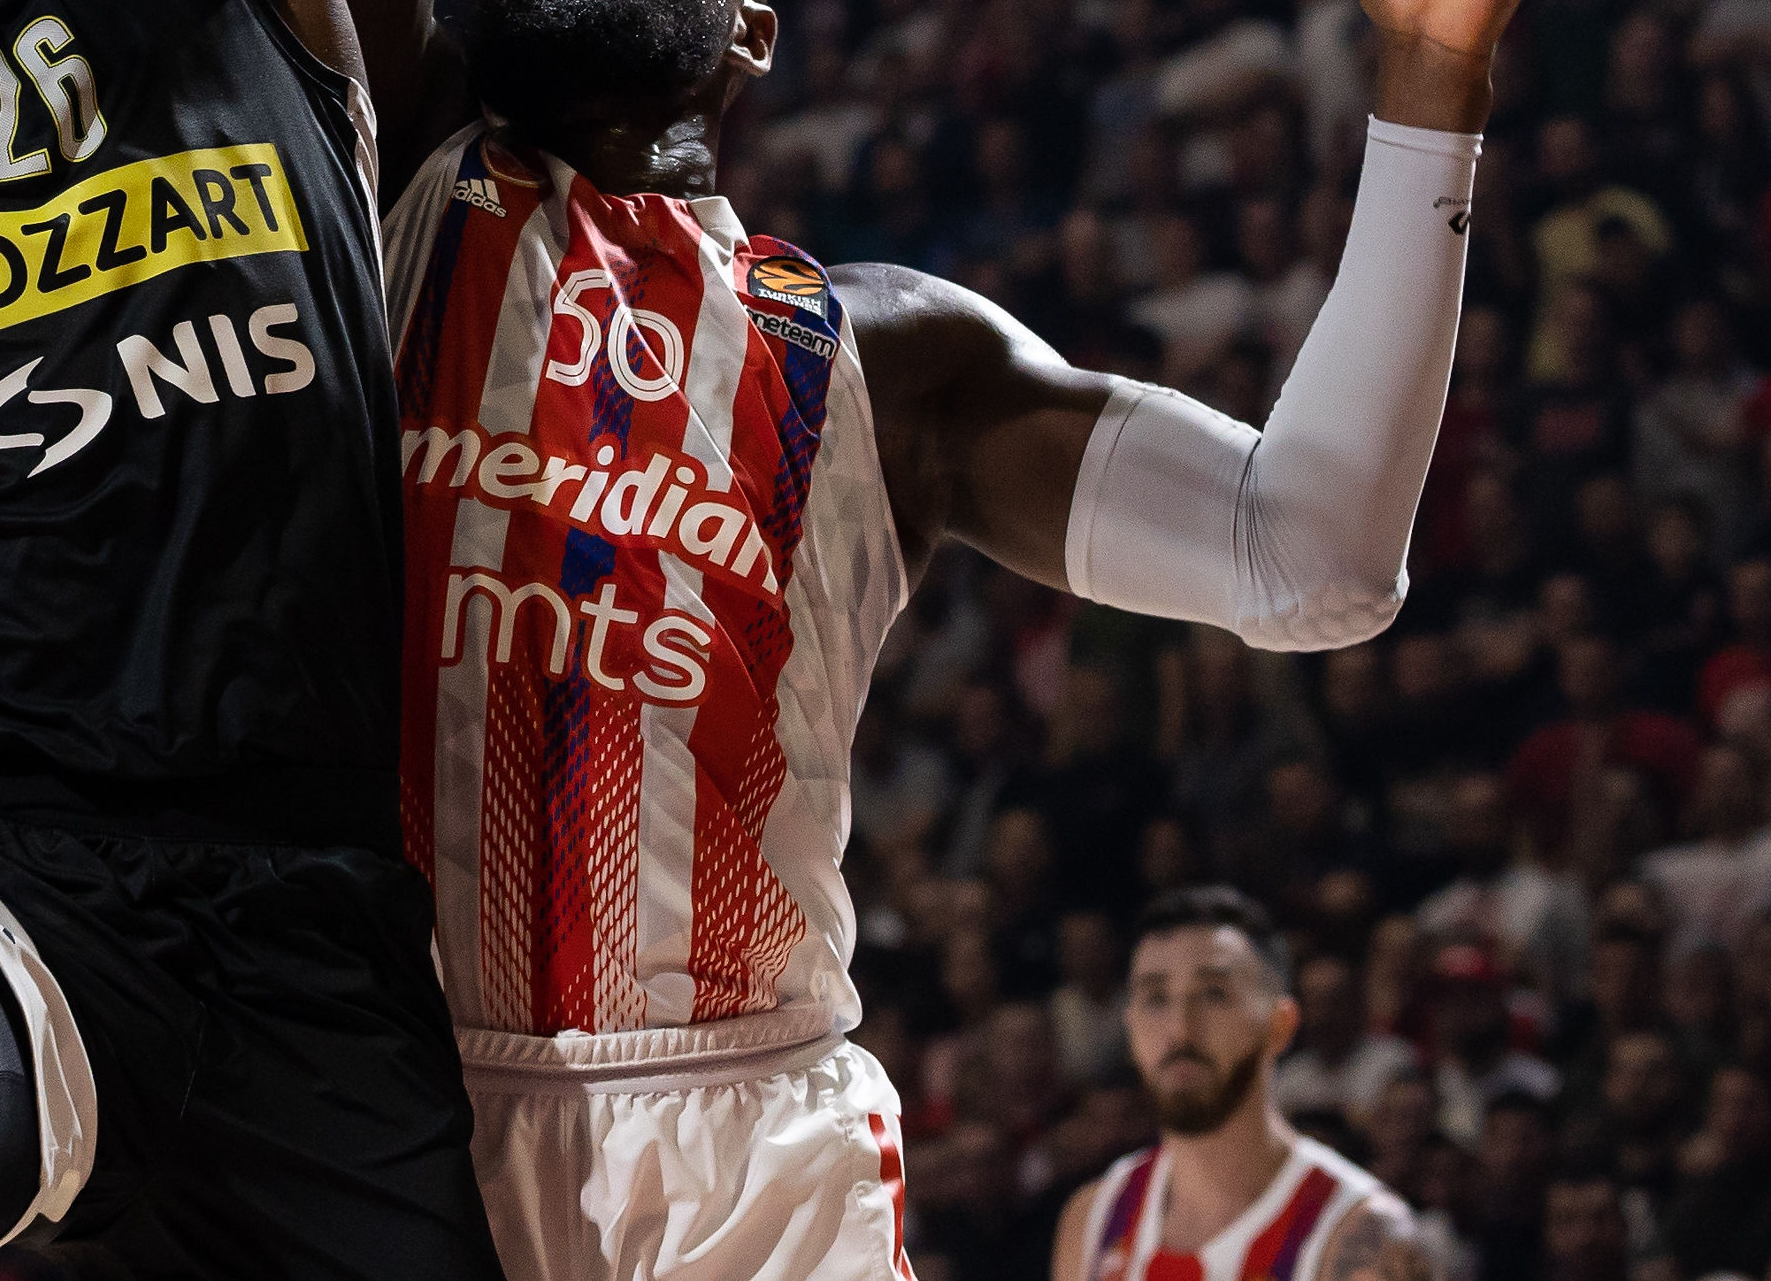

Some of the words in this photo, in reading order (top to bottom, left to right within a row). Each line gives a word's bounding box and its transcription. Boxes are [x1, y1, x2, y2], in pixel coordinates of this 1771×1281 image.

[116, 302, 316, 419] NIS
[545, 269, 685, 402] 50
[441, 573, 714, 701] mts
